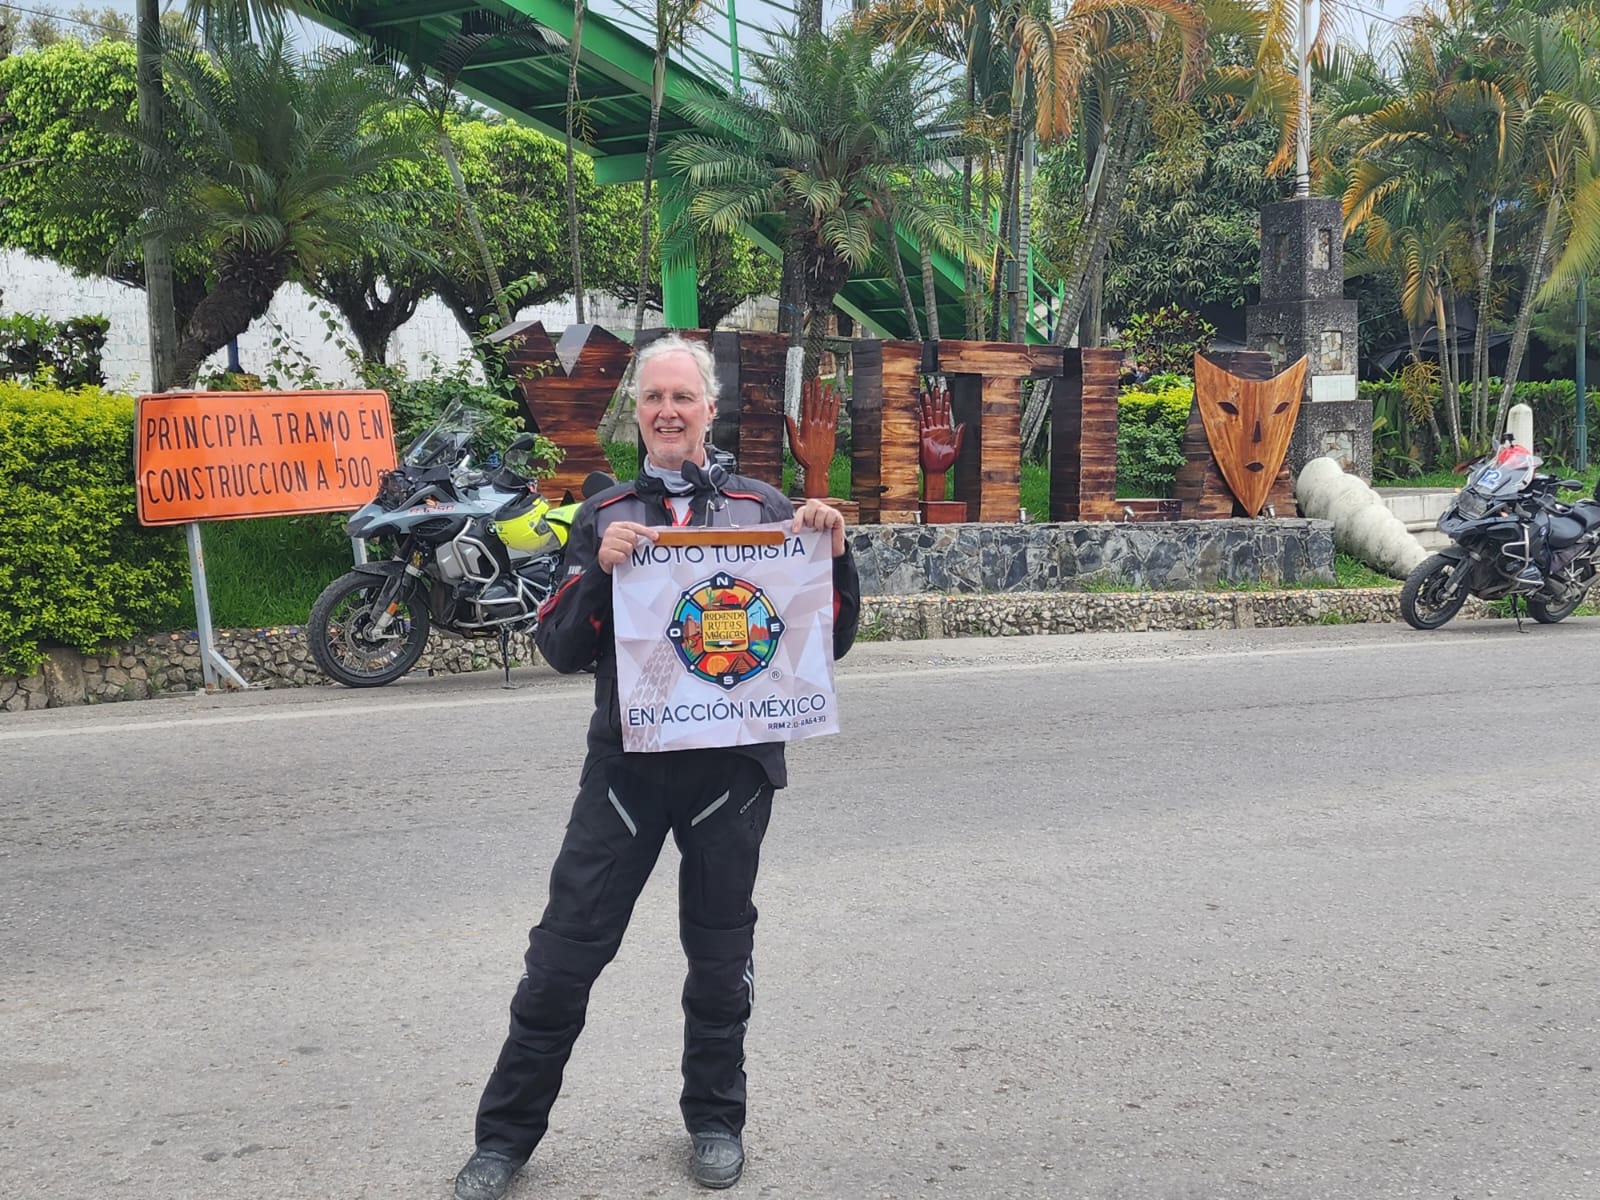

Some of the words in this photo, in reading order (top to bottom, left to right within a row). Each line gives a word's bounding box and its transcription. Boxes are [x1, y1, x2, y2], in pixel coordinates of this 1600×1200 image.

[146, 413, 263, 451] PRINCIPIA
[272, 409, 351, 445] TRAMO
[359, 409, 385, 440] EN
[145, 460, 309, 505] CONSTRUCCION
[316, 459, 330, 490] A
[335, 456, 373, 489] 500
[632, 545, 705, 567] MOTO
[711, 536, 806, 565] TURISTA
[716, 577, 729, 586] N
[669, 628, 681, 637] O
[770, 623, 781, 632] E
[723, 676, 734, 685] S
[629, 706, 656, 727] EN
[661, 698, 744, 725] ACCIÓN
[749, 694, 826, 718] MÉXICO
